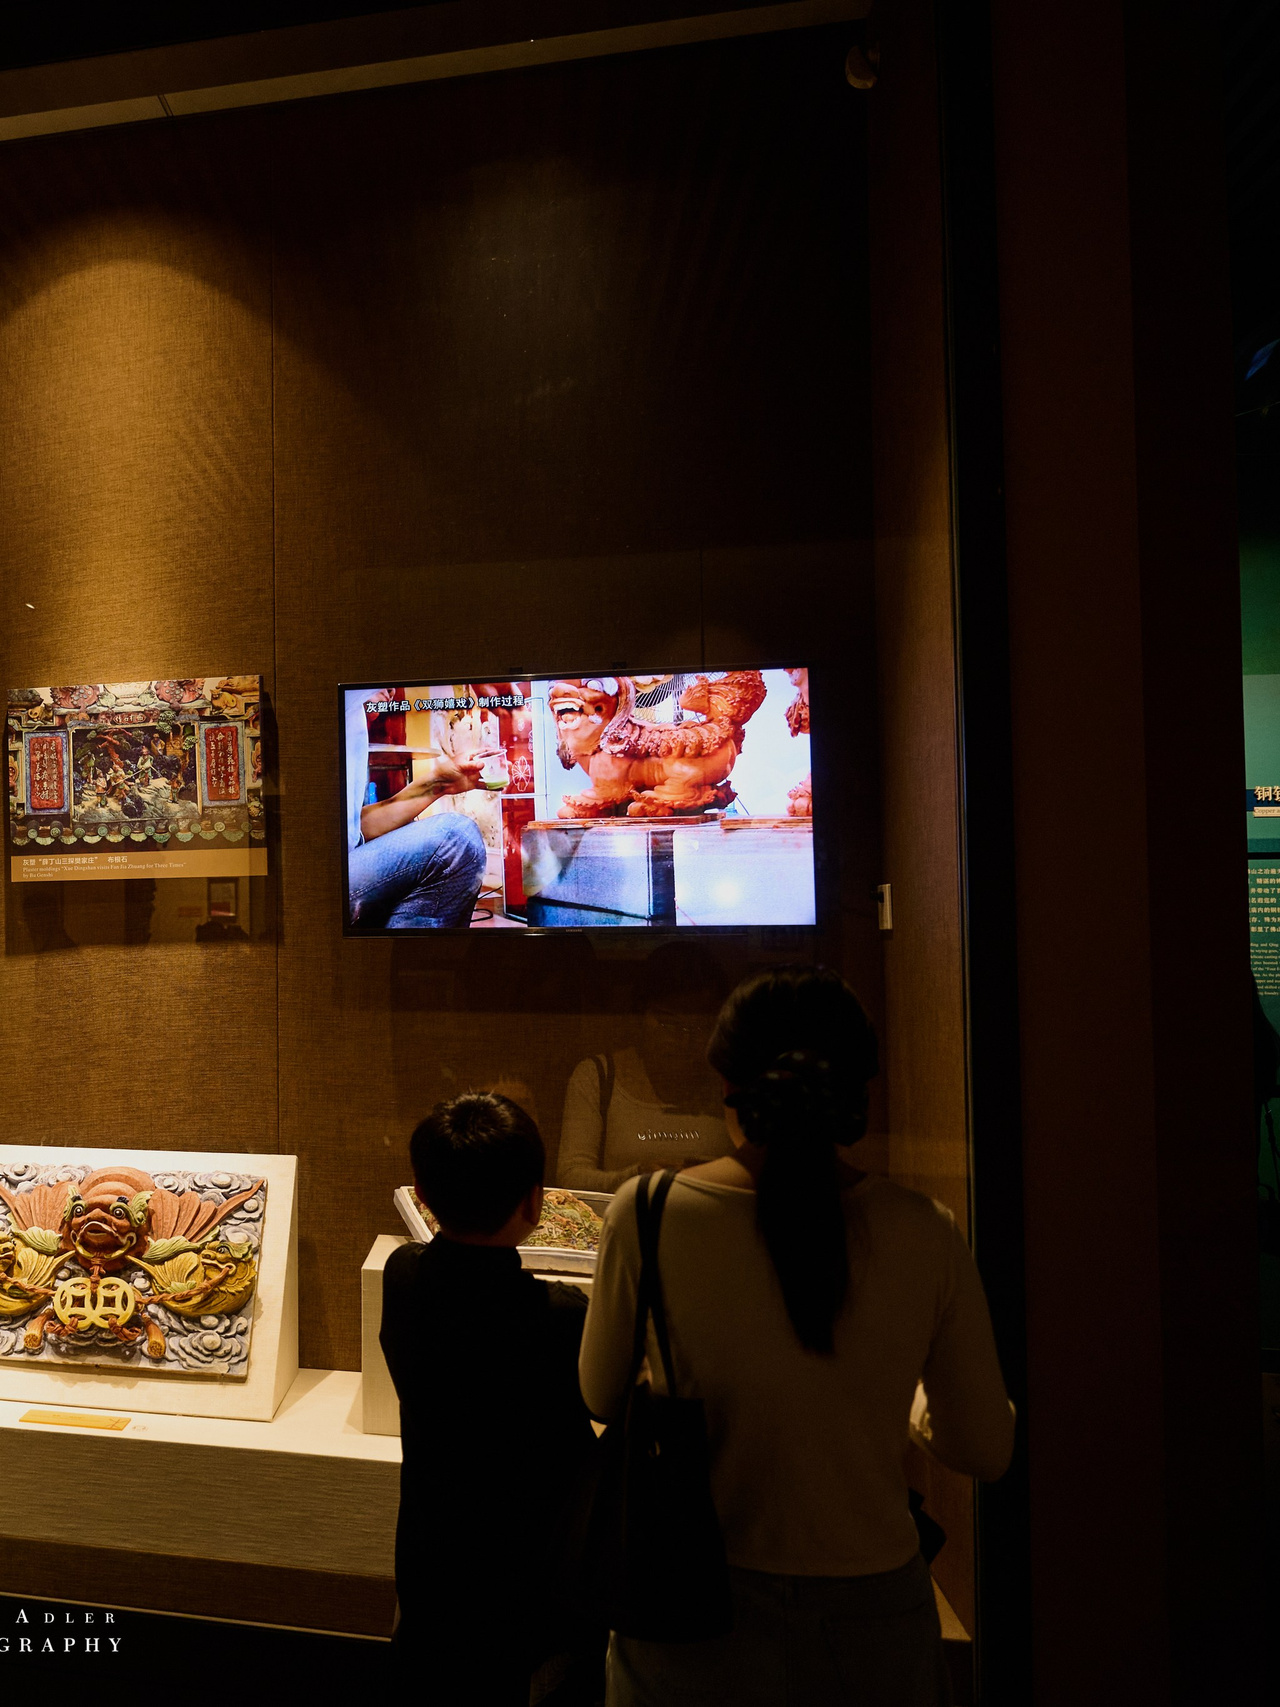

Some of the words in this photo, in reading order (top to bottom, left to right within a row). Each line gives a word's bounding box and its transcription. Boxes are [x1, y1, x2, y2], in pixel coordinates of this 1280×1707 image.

[366, 695, 525, 713] 灰塑作品《双狮嬉戏》制作过程
